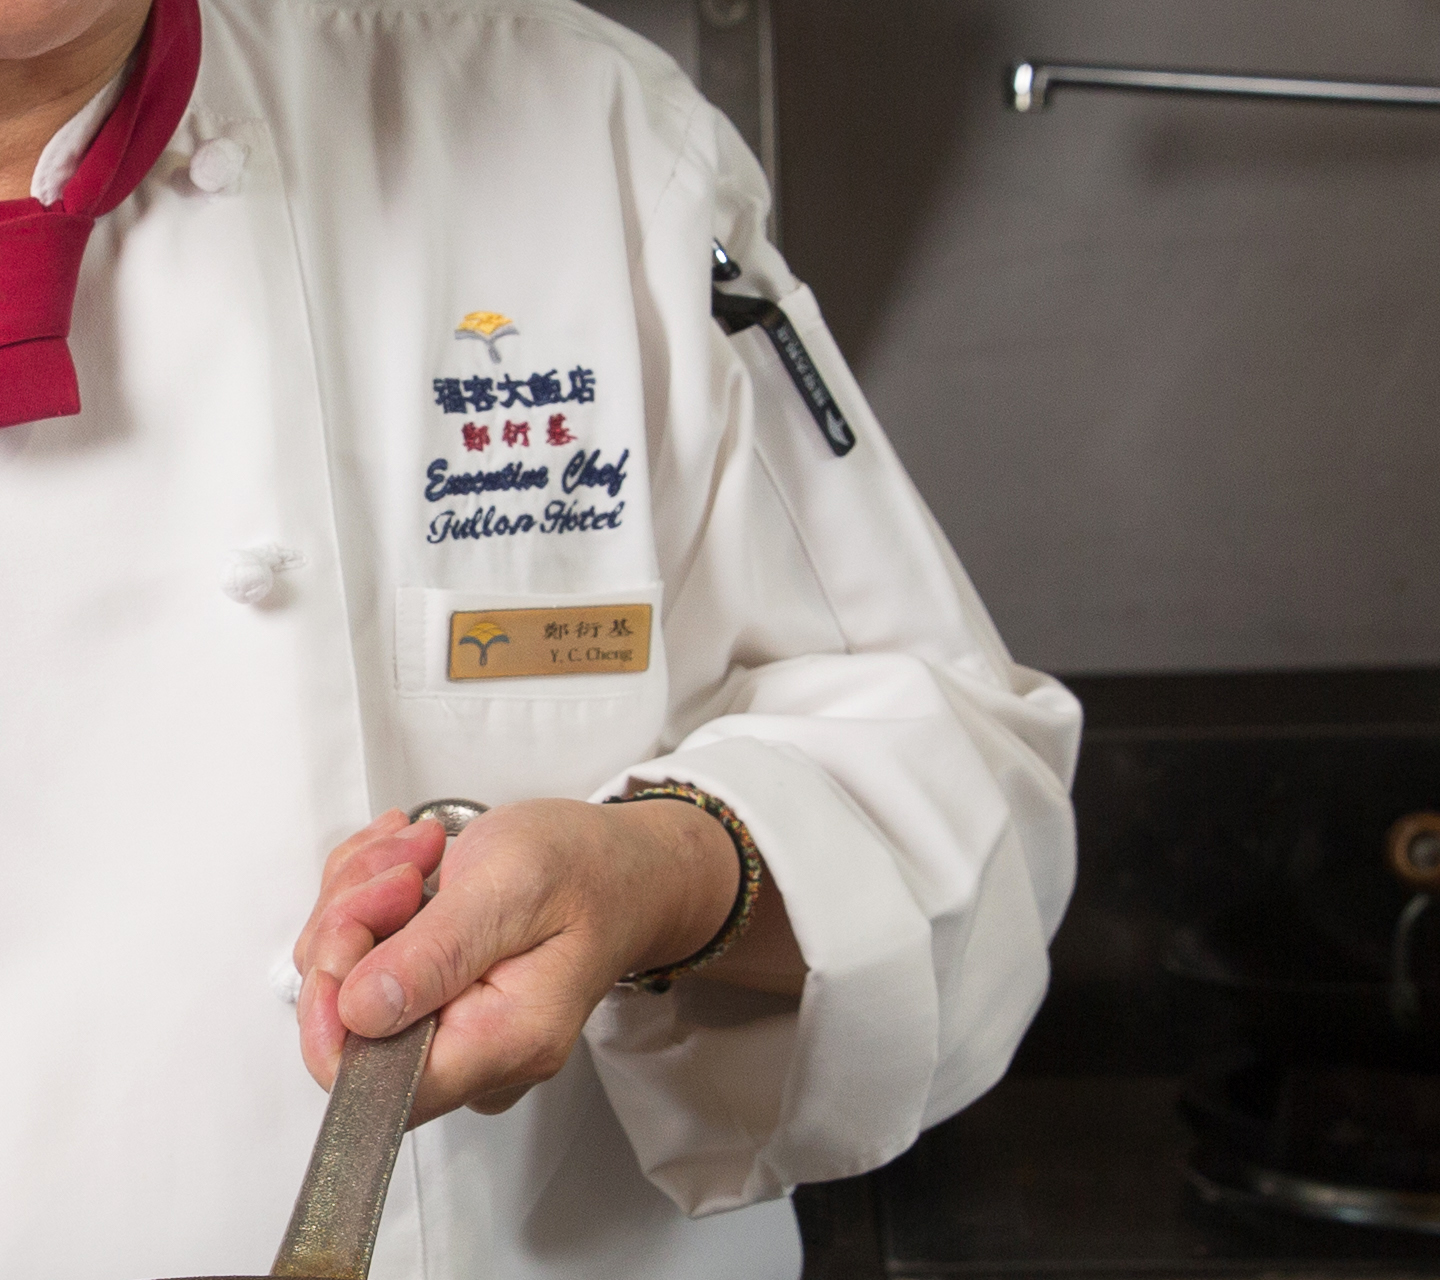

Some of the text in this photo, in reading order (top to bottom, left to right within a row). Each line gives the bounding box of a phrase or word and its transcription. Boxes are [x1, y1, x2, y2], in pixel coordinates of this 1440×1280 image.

[433, 365, 596, 414] 福容大飯店
[425, 448, 630, 502] Executive Chef
[427, 500, 625, 544] Fullon Hotel
[586, 645, 634, 663] Cheng
